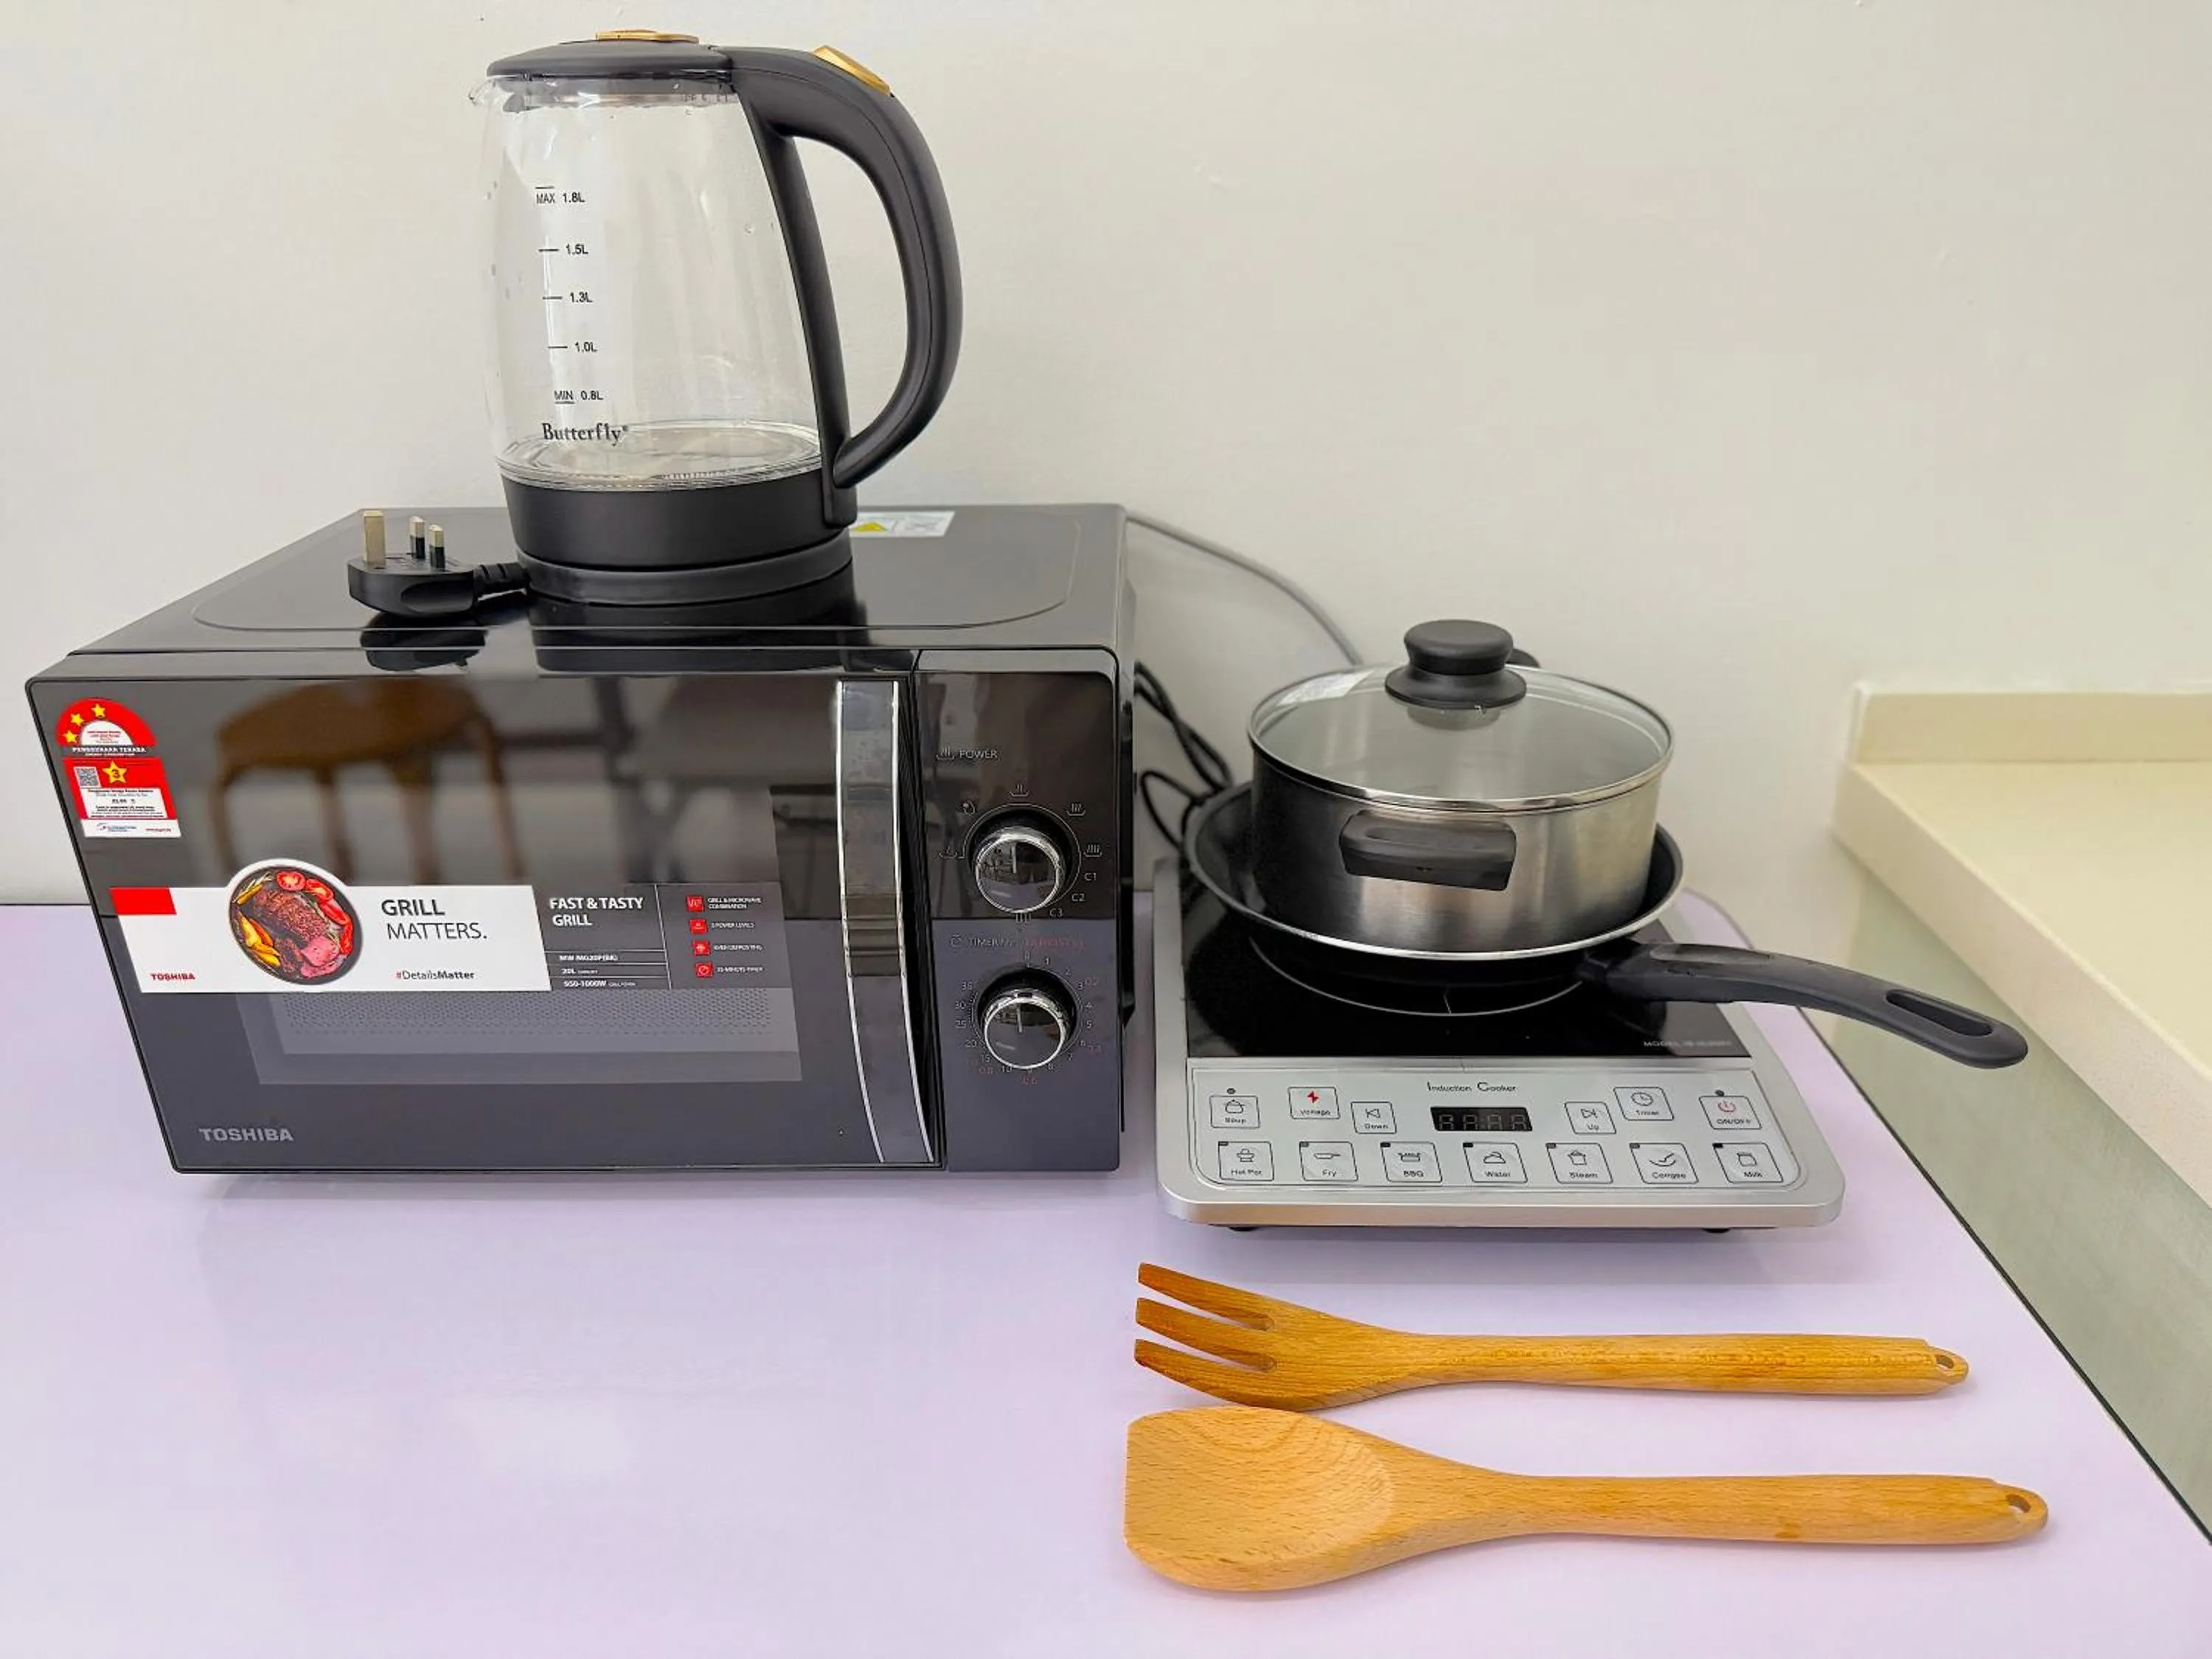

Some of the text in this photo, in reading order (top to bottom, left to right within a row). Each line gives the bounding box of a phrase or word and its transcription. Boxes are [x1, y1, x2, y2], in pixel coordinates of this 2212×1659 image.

[536, 192, 585, 204] MAX 1.8L
[566, 244, 588, 255] 1.5L
[570, 292, 593, 303] 1.3L
[574, 341, 597, 352] 1.0L
[554, 390, 603, 401] MIN 0.8L
[959, 749, 998, 759] POWER
[112, 769, 120, 779] 3
[1085, 872, 1097, 881] C1
[549, 897, 644, 909] FAST & TASTY
[1071, 894, 1086, 902] C2
[380, 899, 445, 916] GRILL
[1049, 908, 1062, 917] C3
[552, 914, 593, 926] GRILL
[386, 922, 487, 940] MATTERS.
[1045, 957, 1050, 965] 1
[395, 970, 475, 980] #DetailsMatter
[961, 981, 973, 990] 35
[1078, 981, 1084, 990] 3
[1085, 1020, 1093, 1029] 5
[965, 1039, 977, 1048] 20
[981, 1054, 991, 1062] 15
[1427, 1082, 1517, 1092] Induction Cooker
[198, 1127, 294, 1142] TOSHIBA
[1322, 1169, 1338, 1178] Fry
